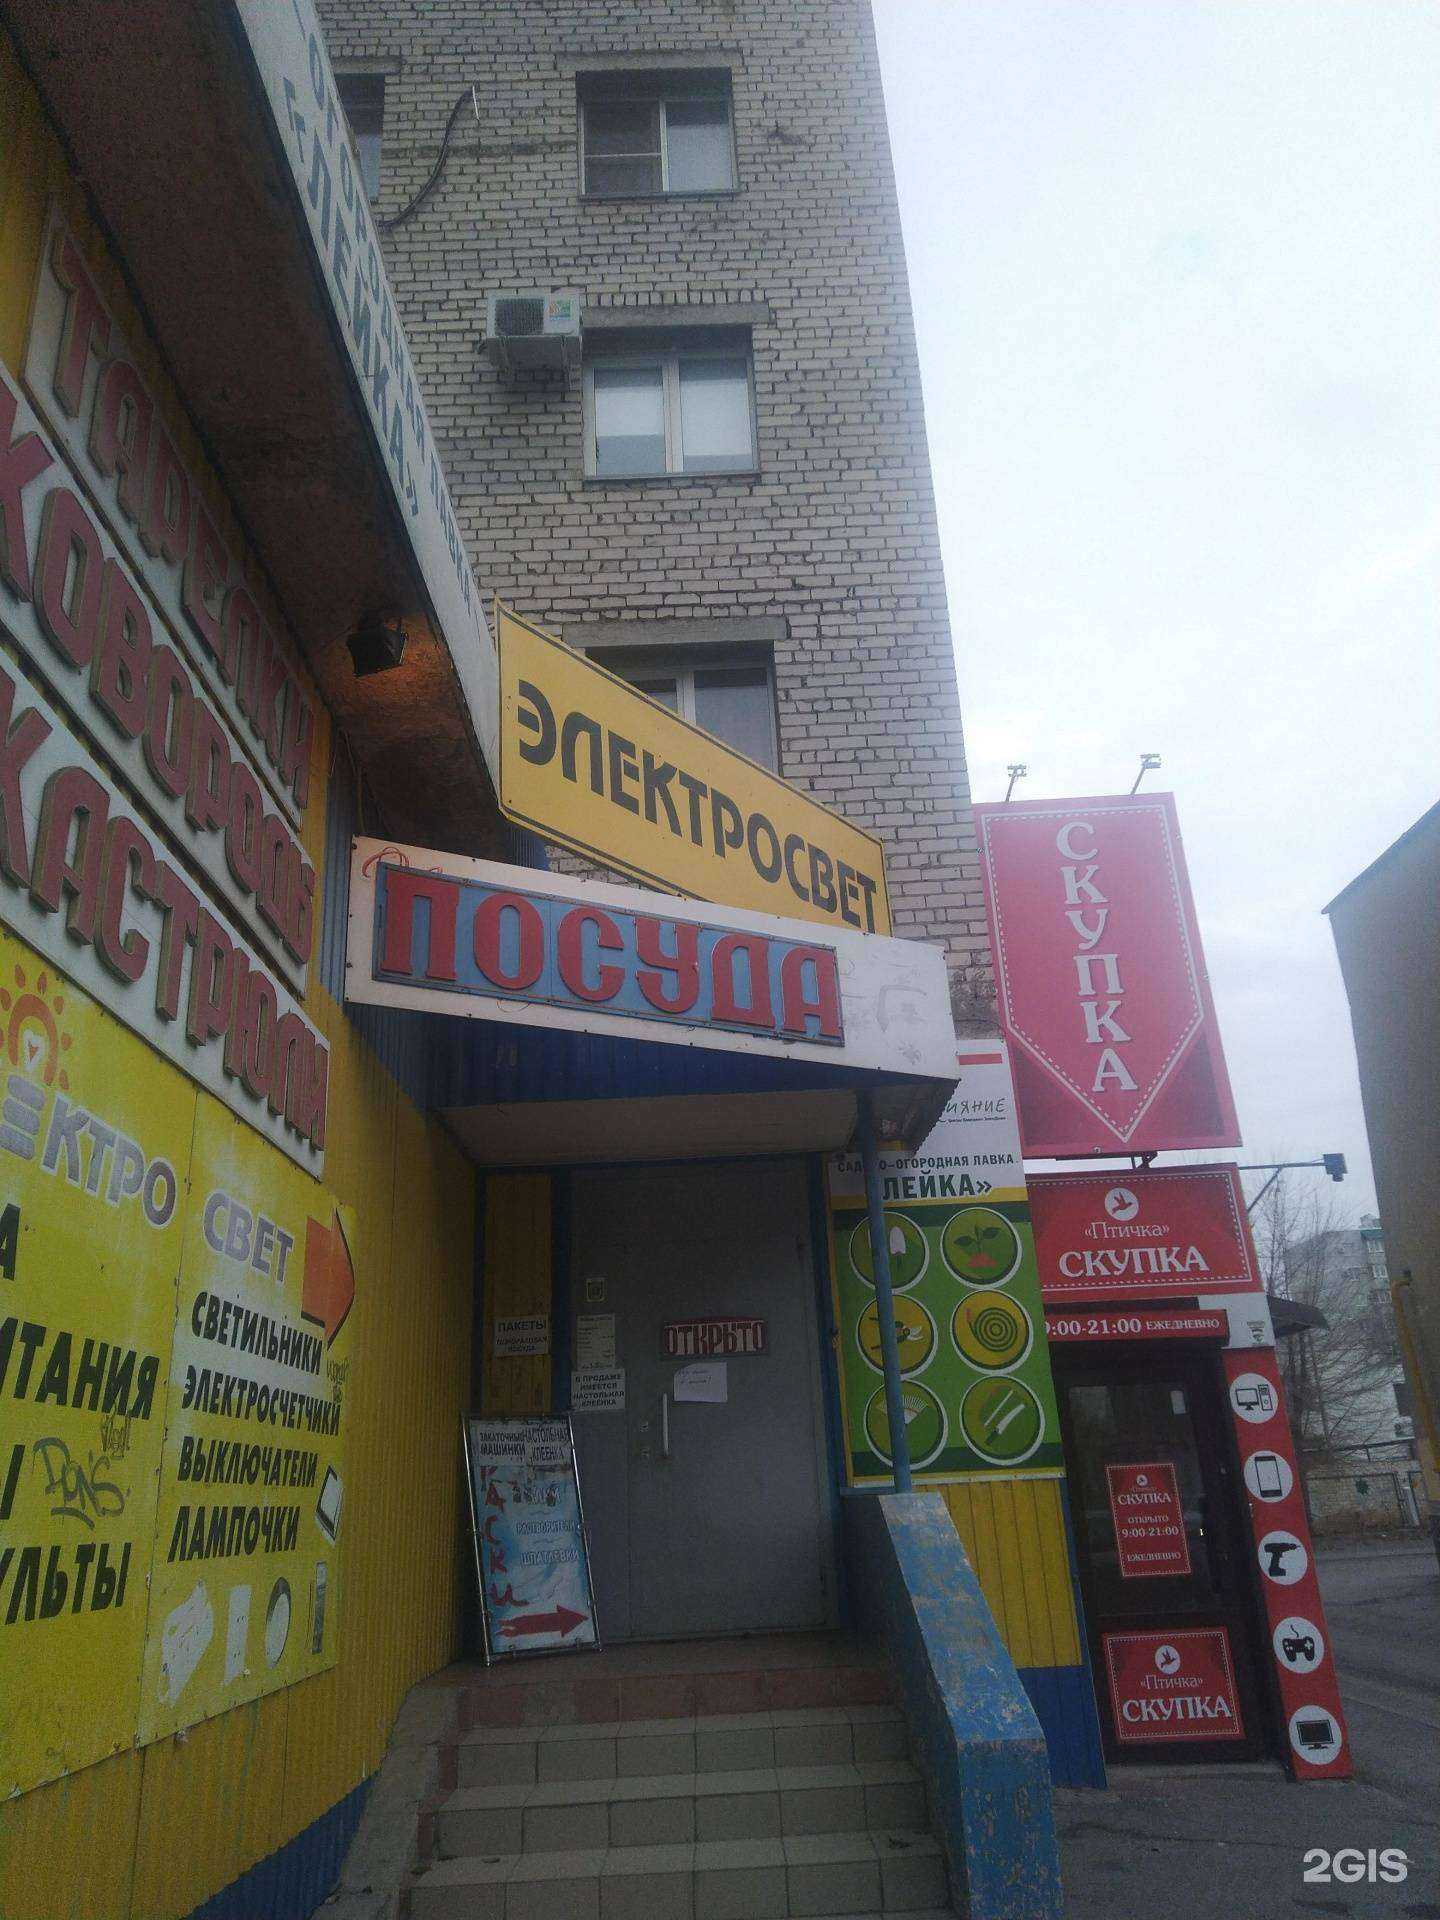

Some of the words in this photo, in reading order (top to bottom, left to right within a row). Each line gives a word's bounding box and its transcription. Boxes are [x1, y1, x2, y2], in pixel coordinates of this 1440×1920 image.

[49, 222, 317, 810] ТАРЕЛКИ
[517, 679, 878, 934] ЭЛЕКТРОСВЕТ
[0, 665, 328, 1152] КАСТРЮЛИ
[380, 872, 842, 1039] ПОСУДА
[1056, 821, 1141, 1093] СКУПКА
[942, 1098, 1005, 1114] ИЯНИЕ
[882, 1170, 993, 1200] ЛЕЙКА»
[973, 1153, 1014, 1166] ЛАВКА
[202, 1192, 294, 1284] СВЕТ
[1084, 1221, 1170, 1239] «Птичка»
[1058, 1245, 1210, 1278] СКУПКА
[191, 1291, 323, 1376] СВЕТИЛЬНИКИ
[1146, 1318, 1220, 1331] ЕЖЕДНЕВНО
[181, 1364, 341, 1437] ЭЛЕКТРОСЧЕТЧИКИ
[177, 1435, 318, 1488] ВЫКЛЮЧАТЕЛИ
[1117, 1492, 1172, 1506] СКУПКА
[166, 1505, 301, 1564] ЛАМПОЧКИ
[1122, 1695, 1232, 1724] СКУПКА
[1140, 1676, 1203, 1692] «Птичка»
